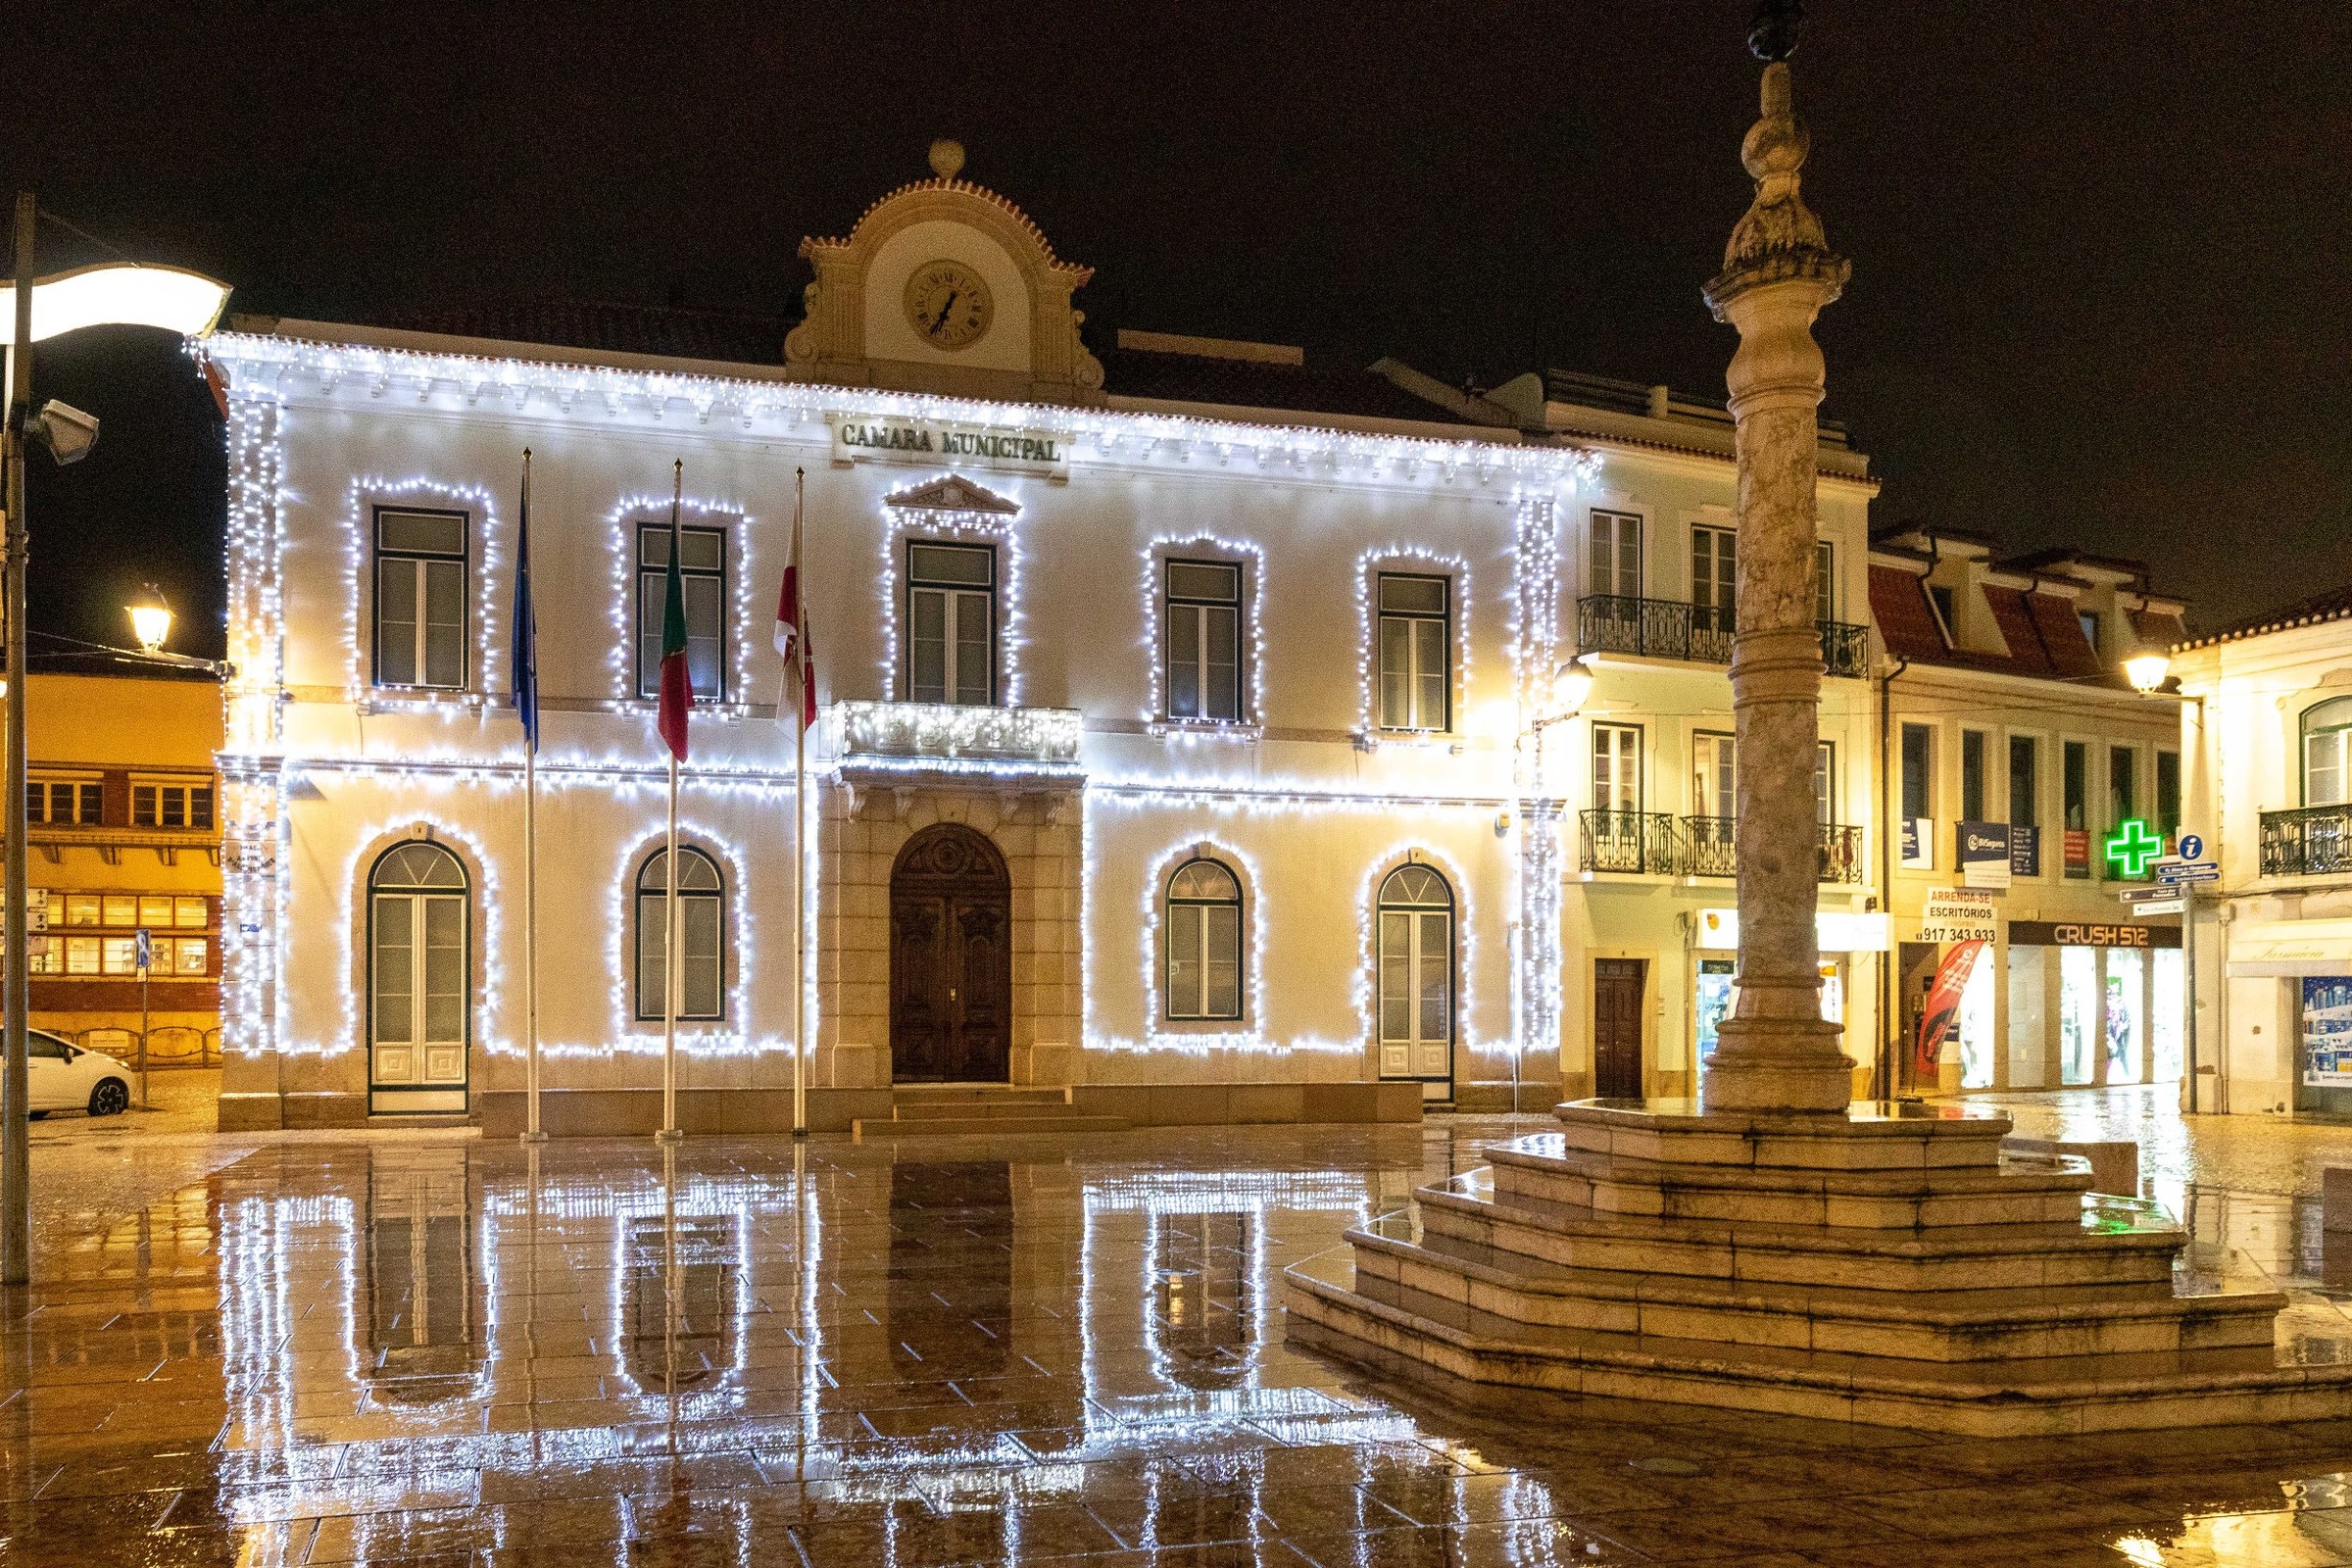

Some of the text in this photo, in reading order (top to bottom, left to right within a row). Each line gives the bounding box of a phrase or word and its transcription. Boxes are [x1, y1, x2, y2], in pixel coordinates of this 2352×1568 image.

[942, 431, 1061, 463] MUNICIPAL
[1932, 891, 1990, 904] ARRENDA-SE
[1930, 906, 1992, 918] ESCRITÓRIOS
[1924, 927, 1995, 942] 917 343 933
[2054, 924, 2148, 947] CRUSH 512
